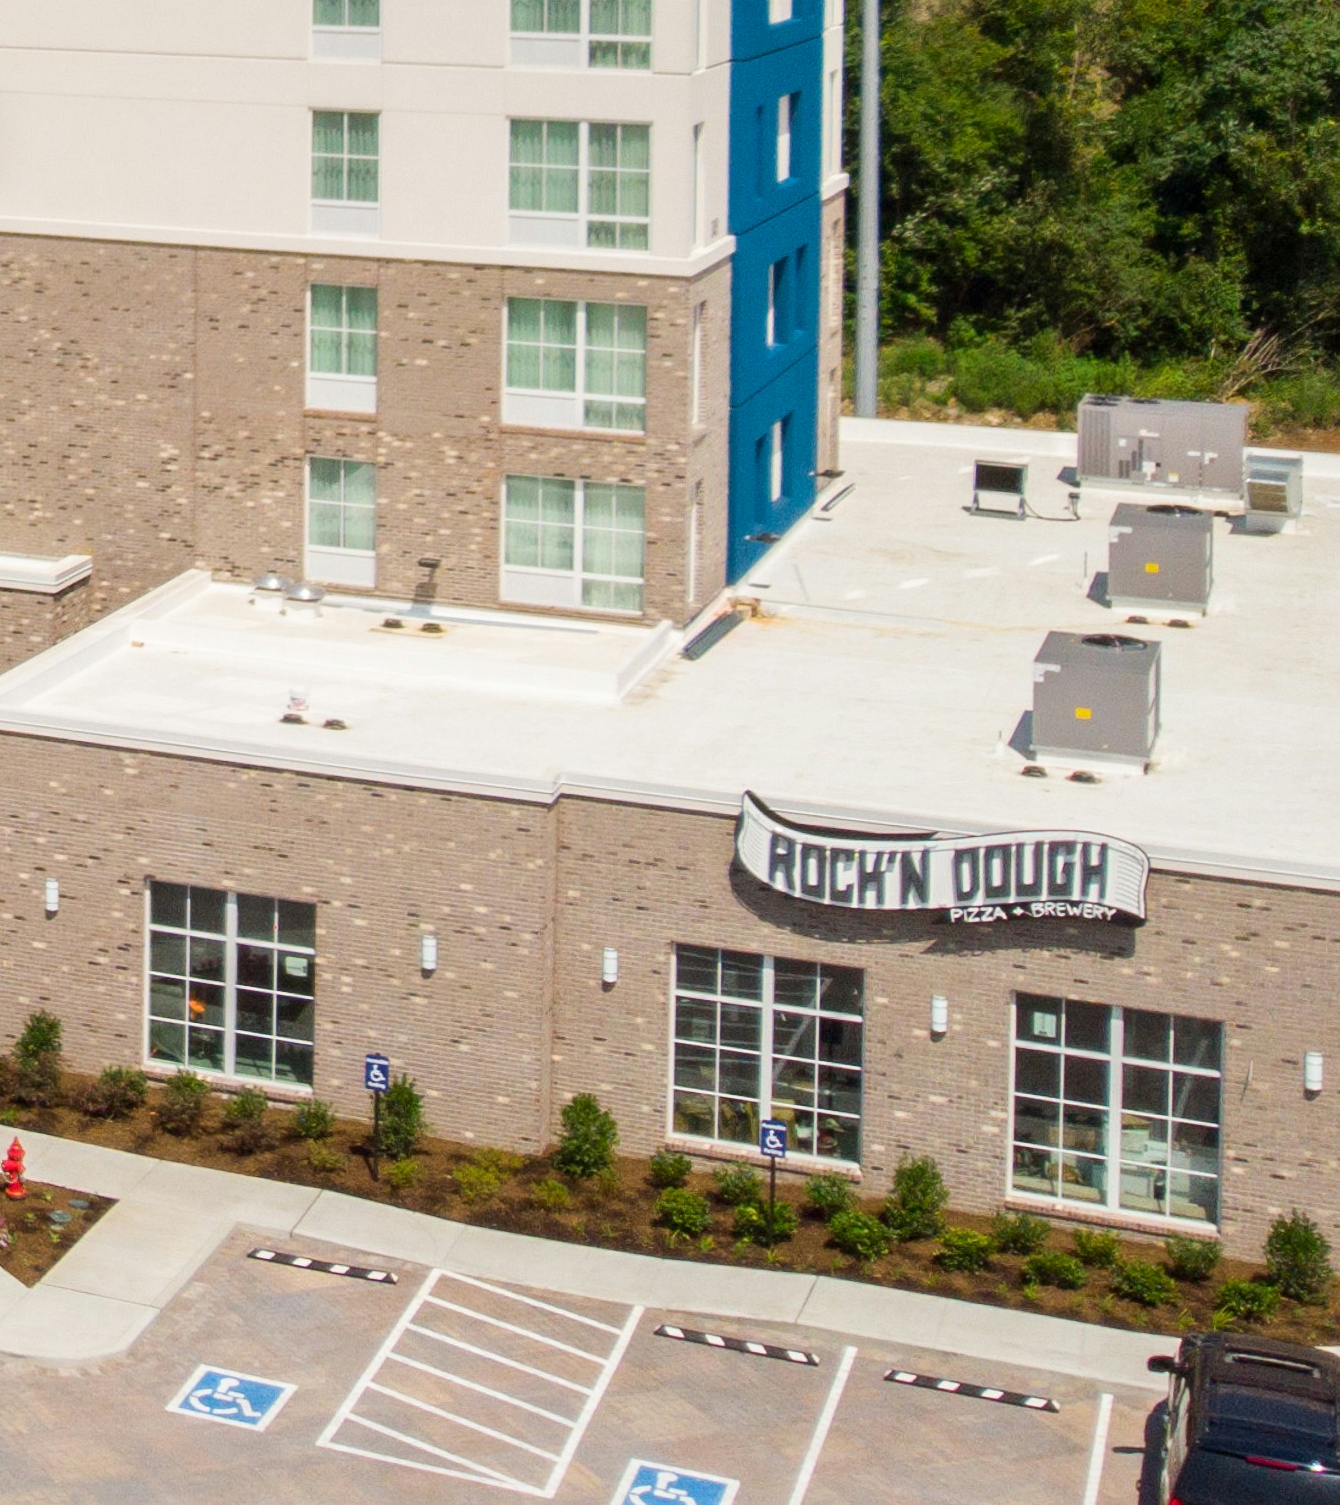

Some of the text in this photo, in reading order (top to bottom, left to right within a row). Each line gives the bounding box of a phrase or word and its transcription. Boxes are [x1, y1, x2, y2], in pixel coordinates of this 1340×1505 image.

[768, 830, 1109, 907] ROCK'N DOUGH
[950, 906, 1008, 923] PIZZA
[1030, 902, 1118, 921] BREWERY
